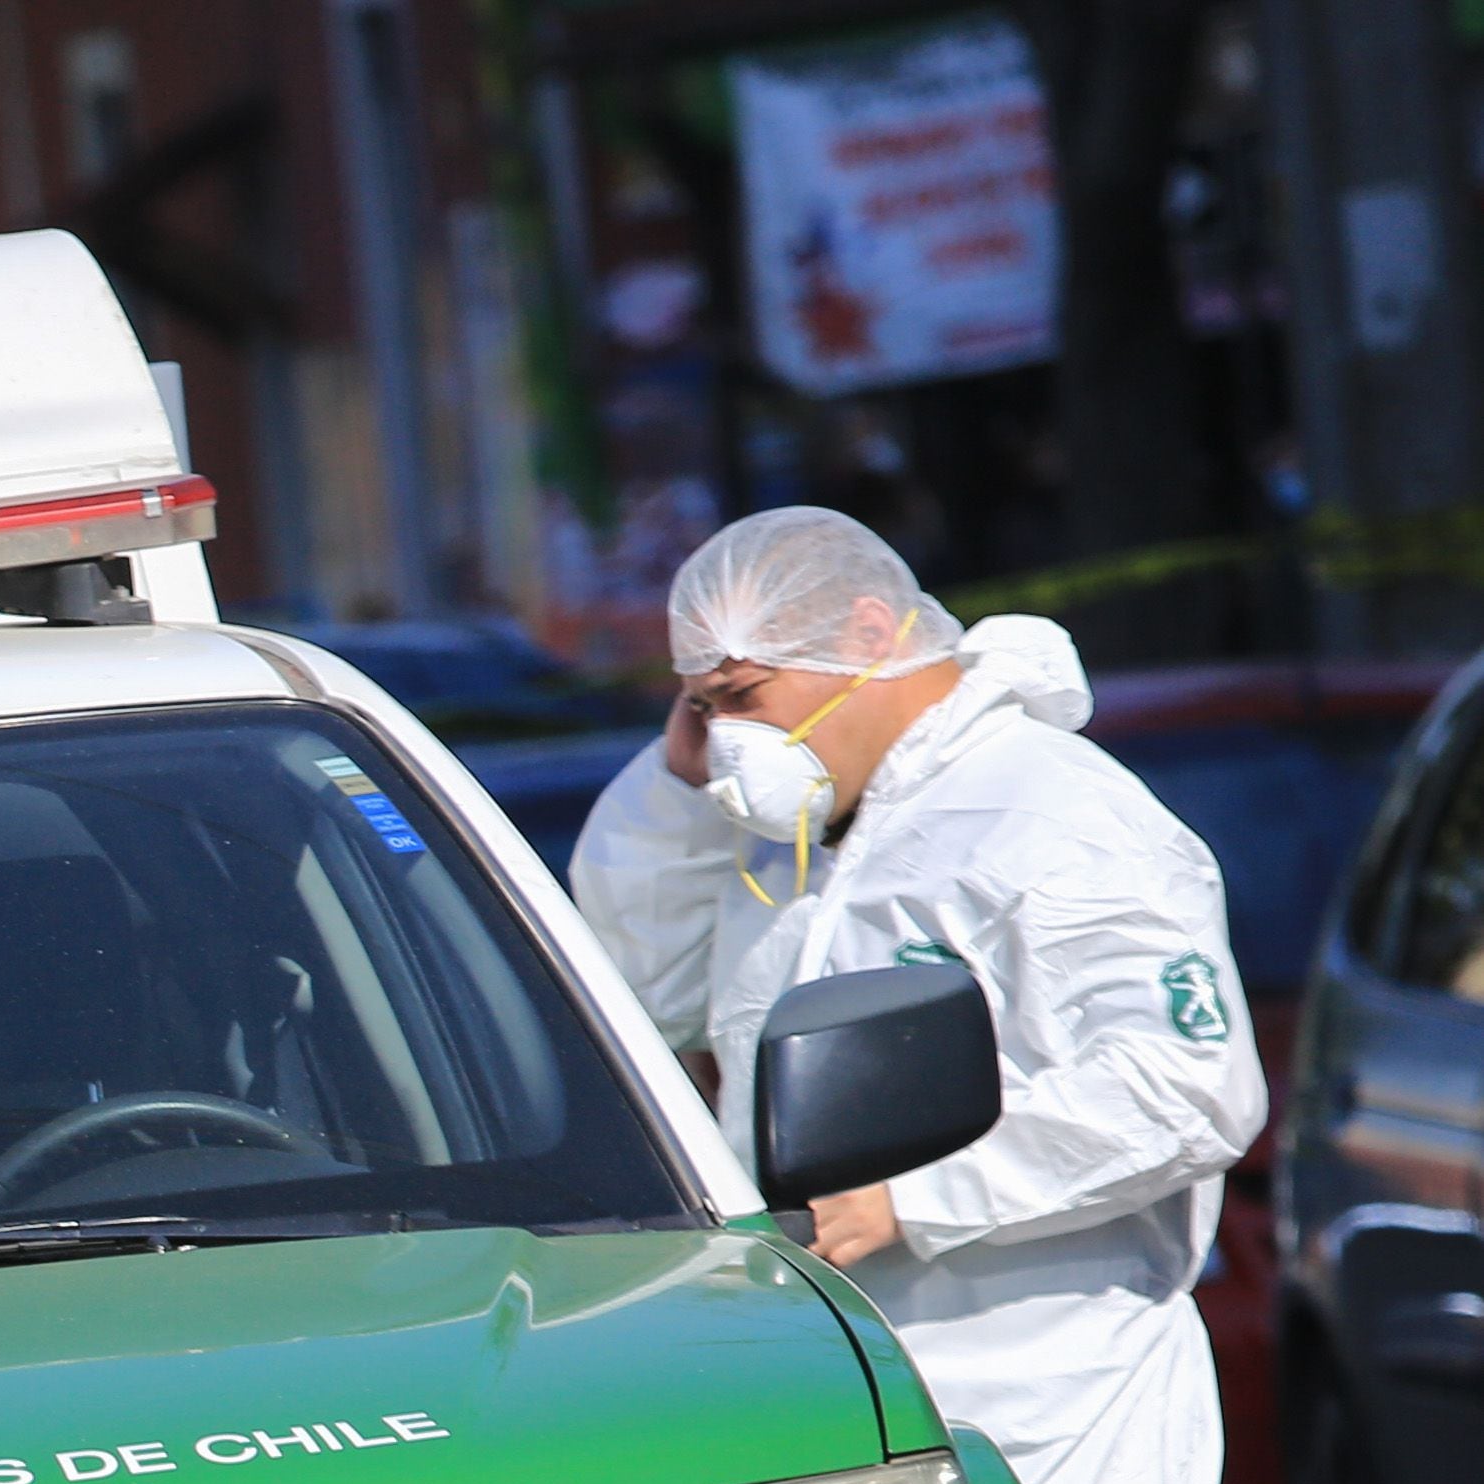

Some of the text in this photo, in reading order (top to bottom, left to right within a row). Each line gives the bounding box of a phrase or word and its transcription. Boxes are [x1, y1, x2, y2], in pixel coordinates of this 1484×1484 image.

[388, 836, 418, 848] OK
[55, 1441, 177, 1483] DE
[193, 1411, 451, 1466] CHILE
